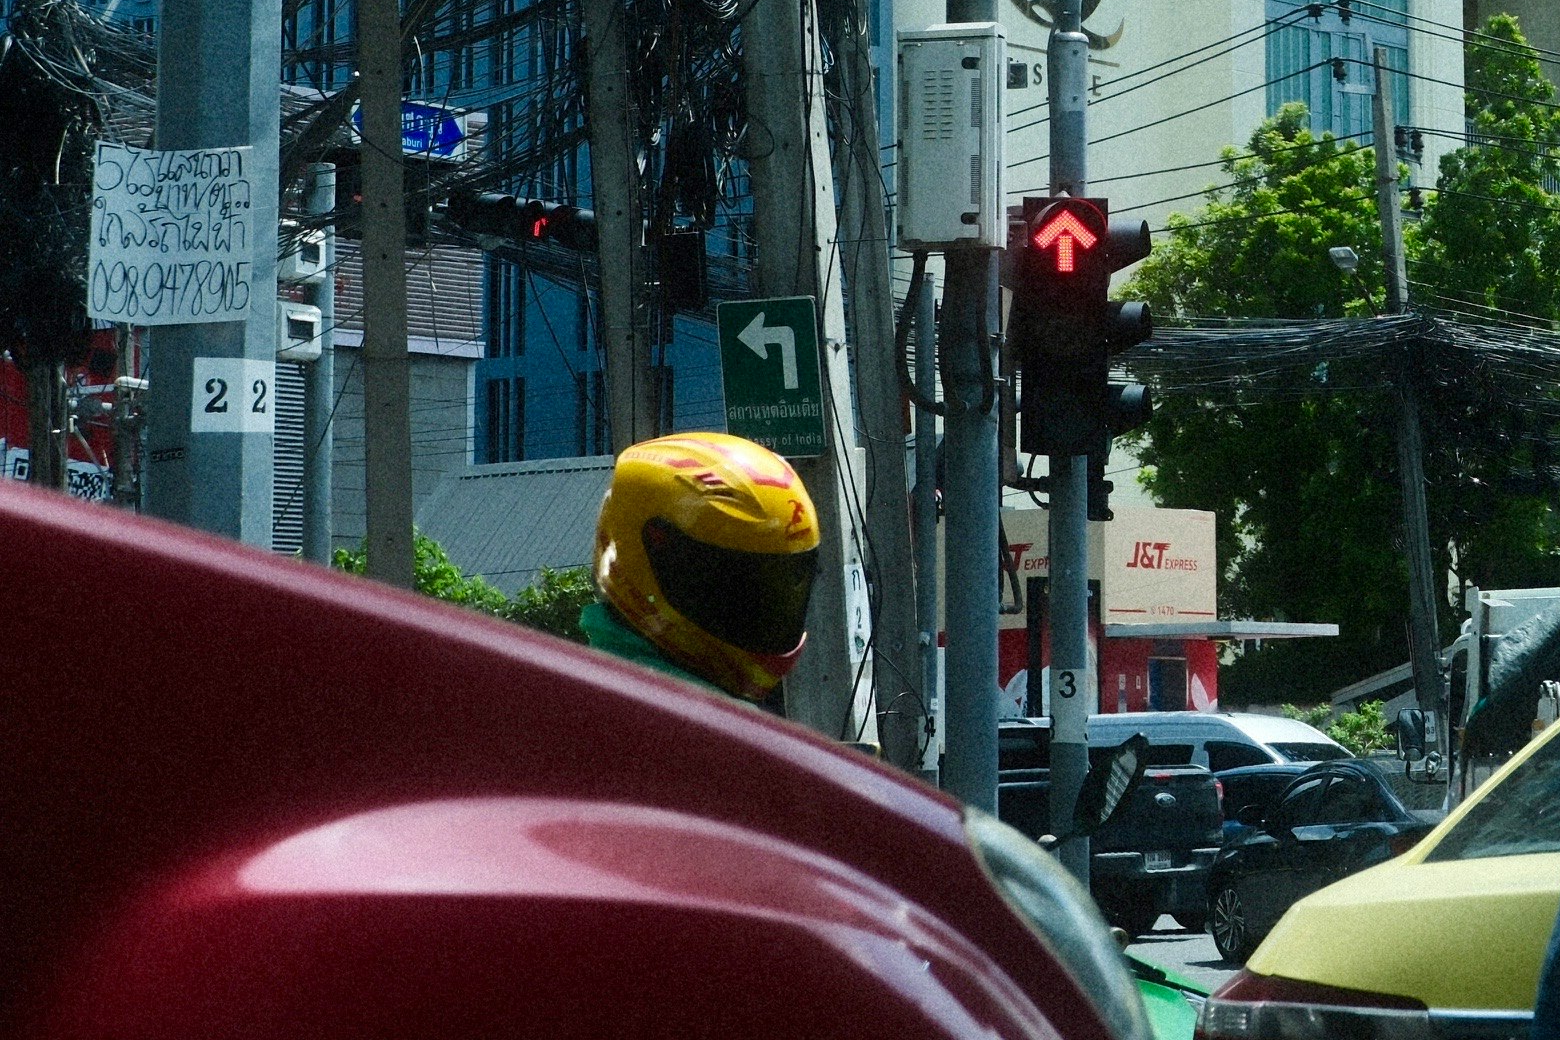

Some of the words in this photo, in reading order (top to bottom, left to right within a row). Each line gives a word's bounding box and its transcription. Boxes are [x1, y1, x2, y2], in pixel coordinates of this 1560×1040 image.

[92, 258, 250, 318] 0989478905
[205, 377, 228, 413] 2
[252, 378, 267, 413] 2
[728, 397, 820, 426] สถานทูตอินเดีย
[781, 434, 792, 446] of
[795, 433, 822, 445] India
[1126, 541, 1171, 569] J&T
[1165, 558, 1198, 571] EXPRESS
[1157, 606, 1175, 616] 1470
[1058, 671, 1077, 699] 3
